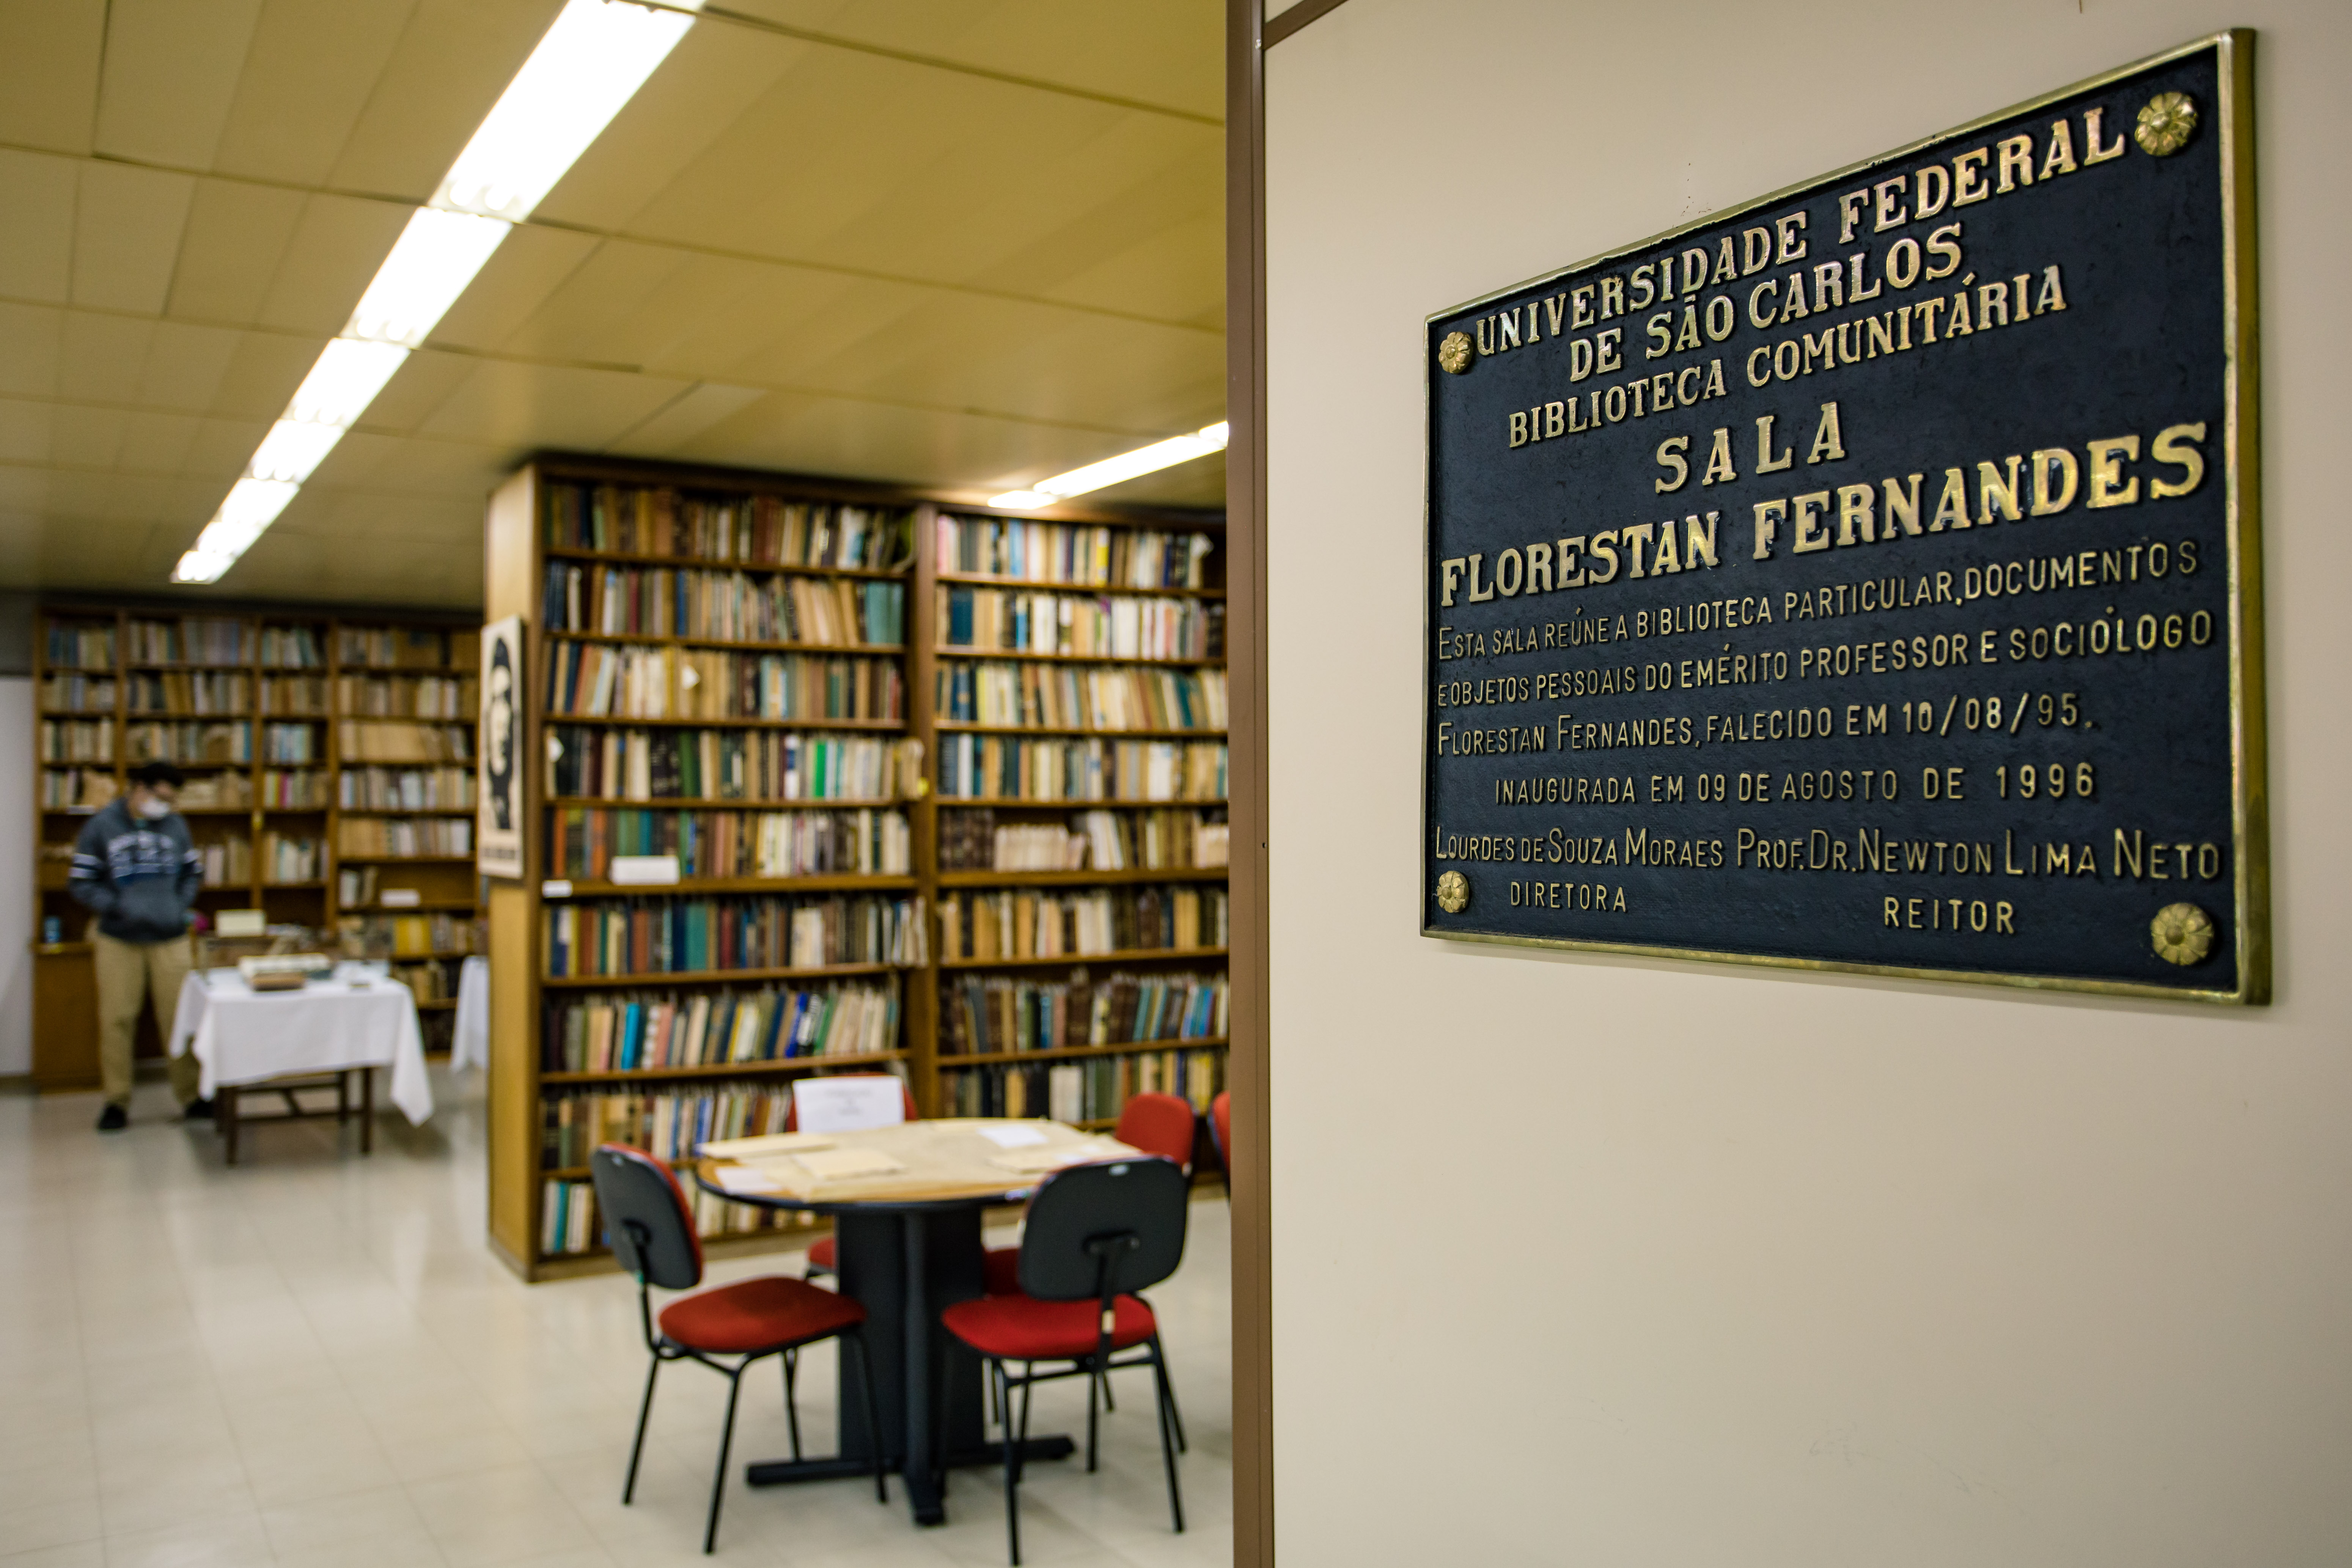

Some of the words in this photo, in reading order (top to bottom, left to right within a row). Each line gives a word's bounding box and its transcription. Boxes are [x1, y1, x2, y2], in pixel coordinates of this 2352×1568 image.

[1476, 211, 1806, 355] UNIVERSIDADE
[1839, 107, 2124, 244] FEDERAL
[1569, 327, 1621, 382] DE
[1645, 294, 1734, 359] SÃO
[1748, 222, 1961, 328] CARLOS
[1509, 359, 1726, 448] BIBLIOTECA
[1747, 265, 2066, 387] COMUNITÁRIA
[1655, 401, 1845, 493] SALA
[1441, 510, 1720, 606] FLORESTAN
[1752, 422, 2206, 560] FERNANDES
[1492, 627, 1538, 654] SALA
[1545, 608, 1608, 647] REÚNE
[1615, 615, 1627, 640] A
[1637, 597, 1772, 637] BIBLIOTECA
[1438, 684, 1447, 706] E
[1451, 677, 1528, 705] OBJETOS
[1536, 666, 1635, 699] PESSOAIS
[1645, 662, 1671, 691] DO
[1681, 643, 1787, 688] EMÉRITO
[1800, 633, 1968, 677] PROFESSOR
[1980, 630, 1997, 662] E
[1558, 714, 1701, 752] FERNANDES,
[1707, 707, 1831, 741] FALECIDO
[1846, 704, 1887, 735] EM
[1496, 777, 1635, 803] INAUGURADA
[1651, 775, 1683, 802] EM
[1698, 774, 1725, 801] 09
[1739, 772, 1769, 802] DE
[1781, 770, 1896, 799] AGOSTO
[1923, 767, 1963, 799] DE
[1997, 762, 2092, 798] 1996
[1521, 838, 1543, 862] DE
[1511, 881, 1626, 912] DIRETORA
[1884, 896, 2013, 933] REITOR
